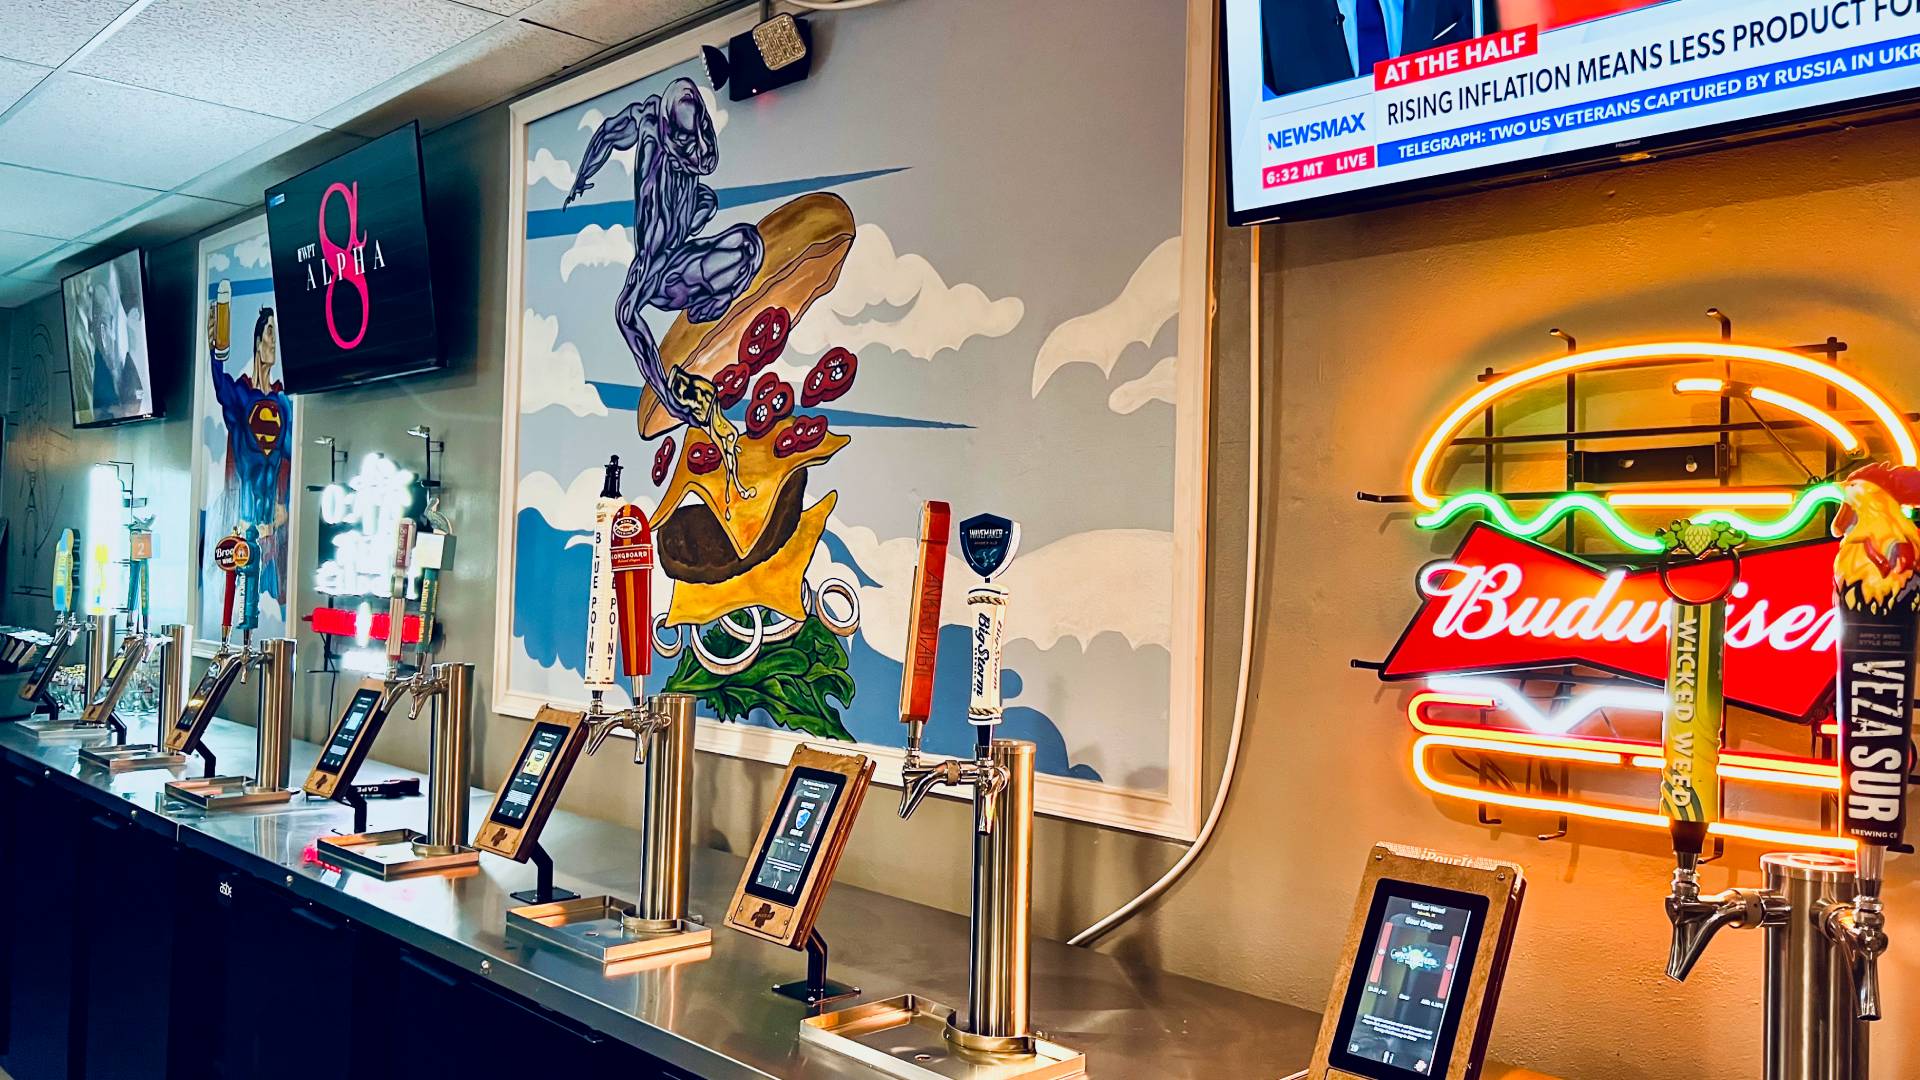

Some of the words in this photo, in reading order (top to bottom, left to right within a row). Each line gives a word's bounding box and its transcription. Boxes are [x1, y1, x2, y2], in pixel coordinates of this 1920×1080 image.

[1384, 63, 1408, 85] AT
[1415, 56, 1459, 78] THE
[1465, 32, 1527, 66] HALF
[1388, 91, 1453, 126] RISING
[1459, 63, 1571, 111] INFLATION
[1577, 42, 1662, 86] MEANS
[1669, 28, 1726, 66] LESS
[1733, 0, 1866, 52] PRODUCT
[1875, 0, 1920, 22] FO
[1267, 112, 1366, 151] NEWSMAX
[1398, 131, 1487, 160] TELEGRAPH:
[1489, 122, 1527, 142] TWO
[1529, 115, 1551, 132] US
[1553, 96, 1641, 129] VETERANS
[1643, 78, 1742, 111] CAPTURED
[1745, 71, 1772, 90] BY
[1774, 57, 1848, 86] RUSSIA
[1851, 51, 1874, 71] IN
[1265, 163, 1300, 186] 6:32
[1302, 160, 1324, 177] MT
[1336, 152, 1368, 172] LIVE
[306, 239, 386, 291] ALPHA
[593, 531, 602, 589] BLUE
[586, 597, 598, 670] POINT
[607, 597, 617, 670] POINT
[1420, 562, 1840, 652] Budwiser
[1675, 618, 1698, 722] WICKED
[1852, 660, 1906, 738] VEZA
[1672, 732, 1693, 807] WEED
[1848, 745, 1903, 823] SUR
[1851, 828, 1888, 839] BREWING
